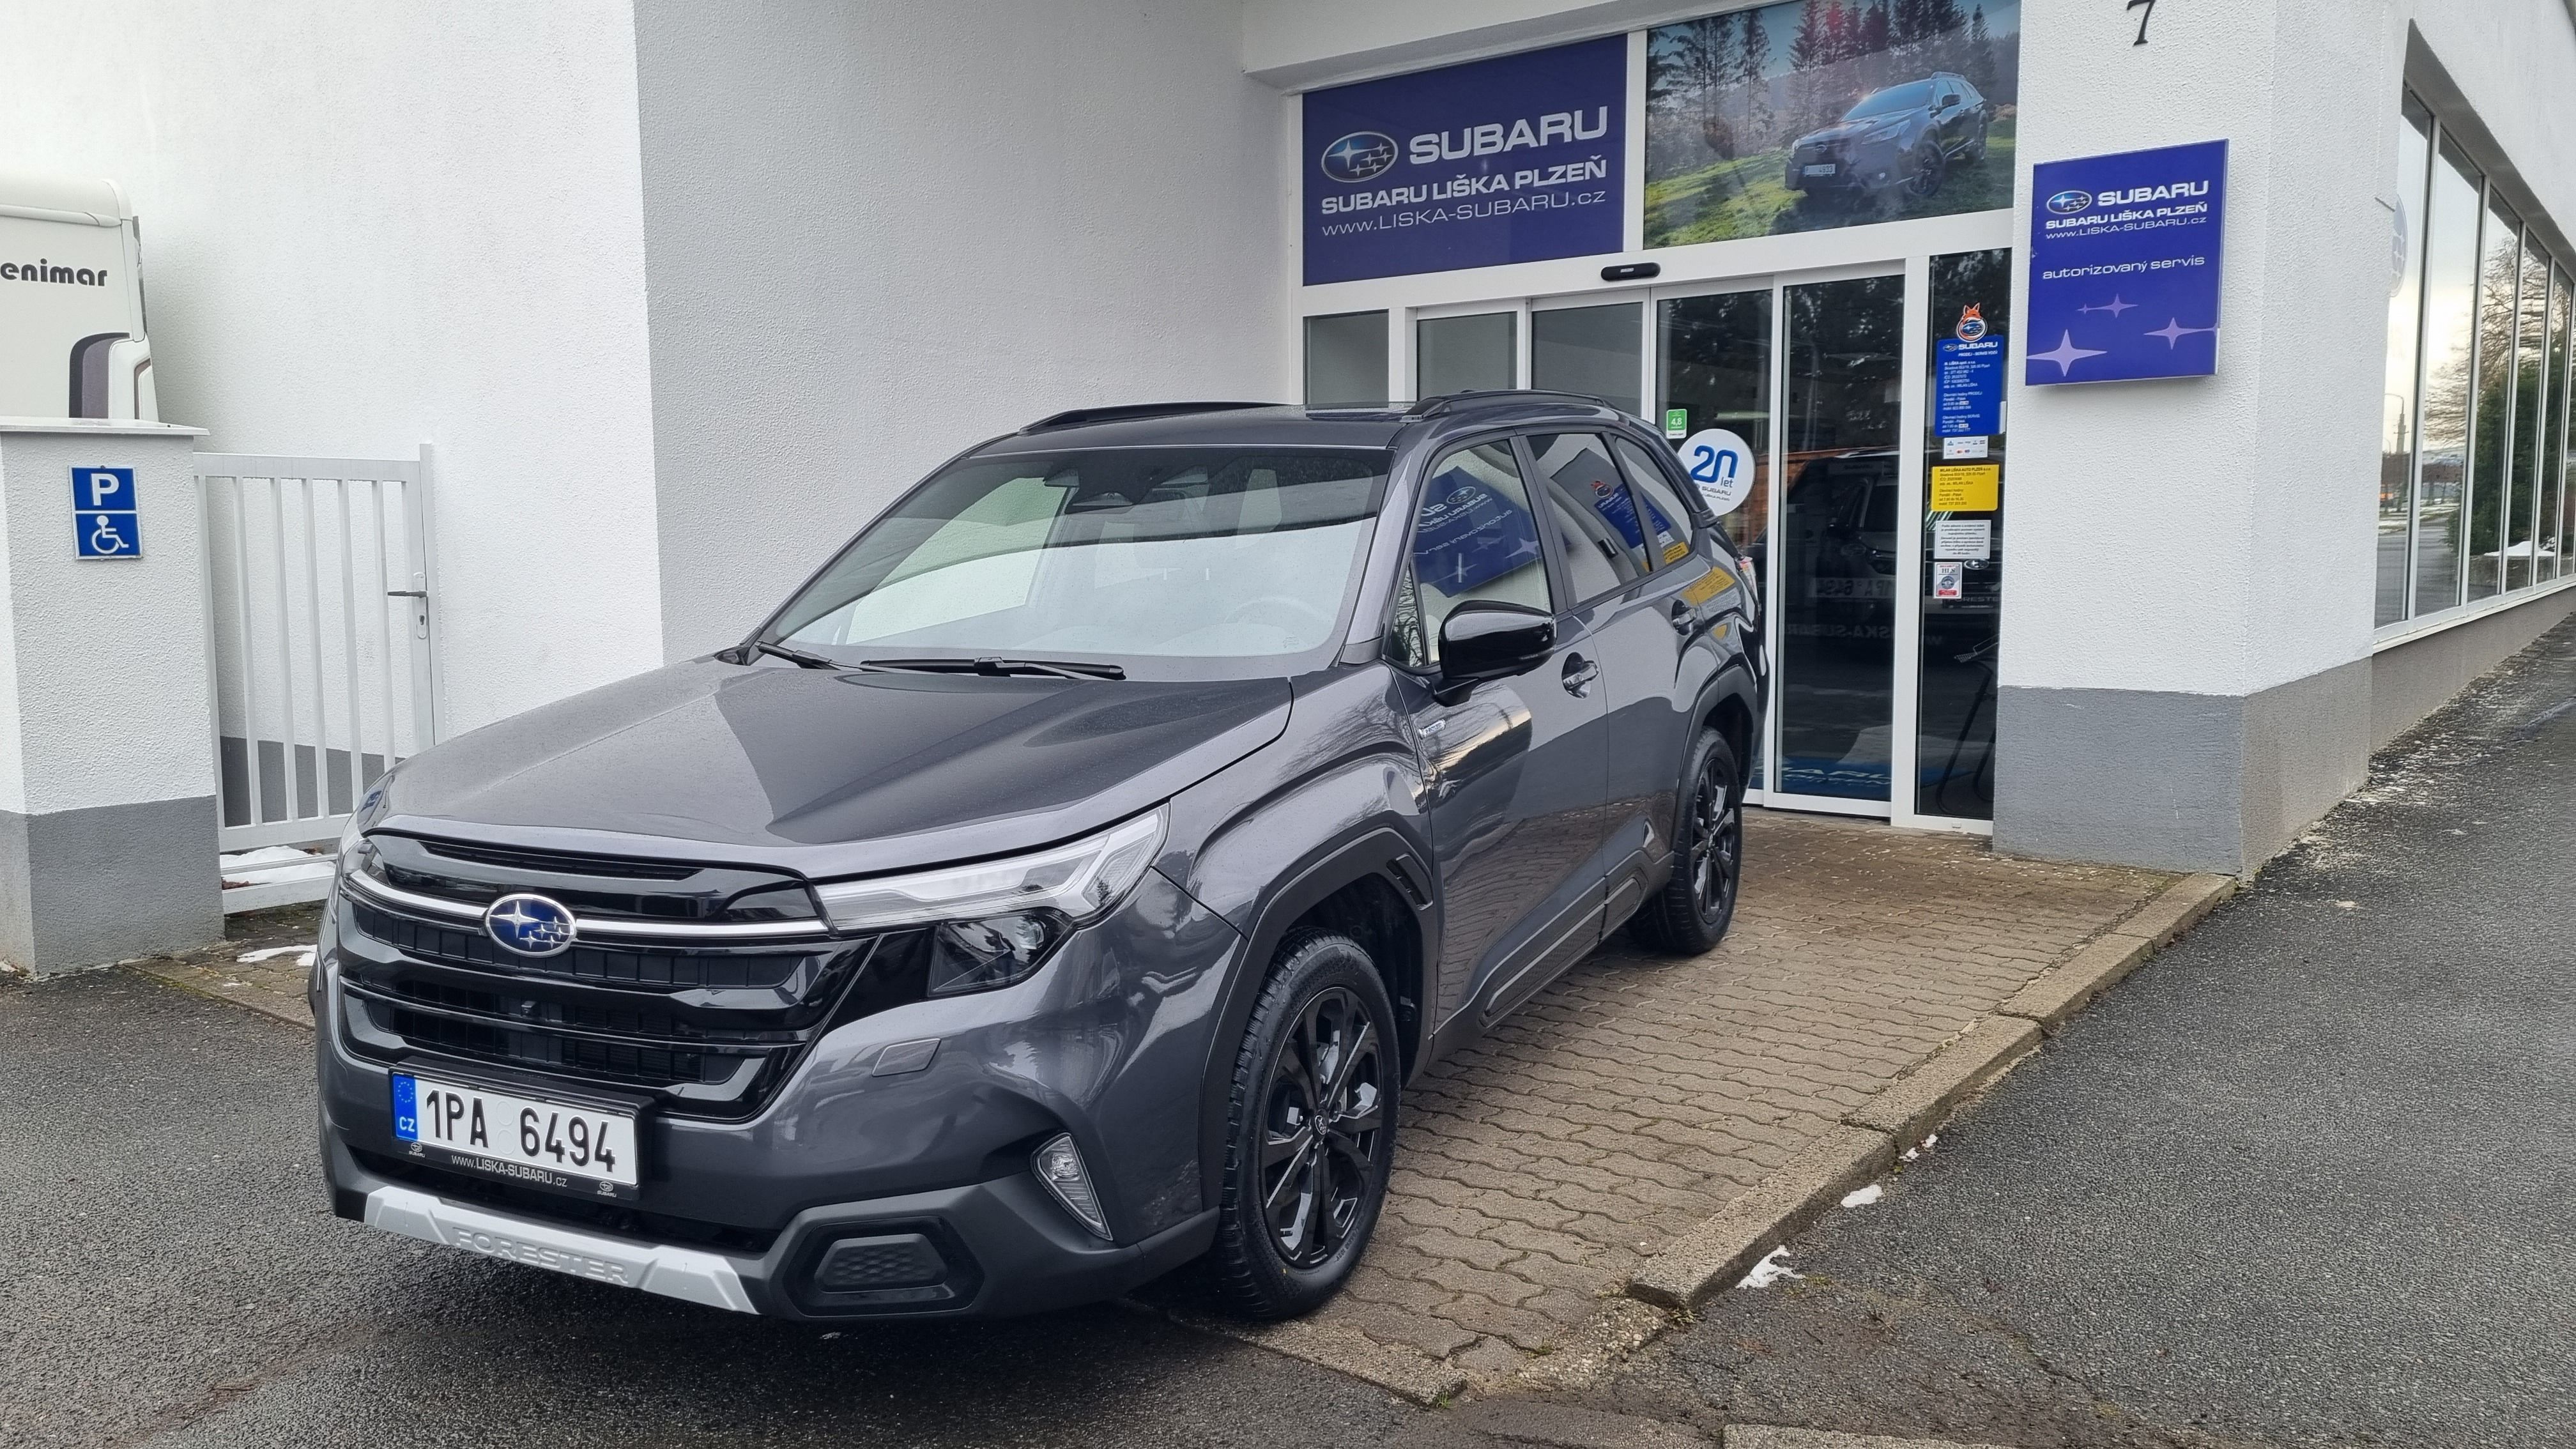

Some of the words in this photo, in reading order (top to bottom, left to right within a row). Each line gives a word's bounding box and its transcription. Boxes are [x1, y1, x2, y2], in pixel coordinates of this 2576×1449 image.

[2127, 0, 2155, 46] 7
[1409, 105, 1608, 164] SUBARU
[1321, 183, 1430, 215] SUBARU
[1433, 174, 1510, 201] LIŠKA
[1515, 155, 1607, 189] PLZEŇ
[2097, 180, 2209, 207] SUBARU
[1321, 190, 1607, 236] www.LISKA-SUBARU.cz
[2046, 214, 2108, 229] SUBARU
[2110, 210, 2154, 222] LIŠKA
[2156, 201, 2208, 217] PLZEŇ
[2046, 216, 2207, 240] www.LISKA-SUBARU.cz
[0, 258, 108, 287] enimar
[2043, 260, 2147, 280] autorizovaný
[2150, 255, 2205, 270] servis
[1958, 342, 1998, 350] SUBARU
[91, 473, 119, 506] P
[1701, 486, 1731, 496] SUBARU
[1721, 476, 1733, 488] let
[399, 1116, 415, 1133] CZ
[426, 1089, 489, 1149] 1PA
[519, 1107, 616, 1173] 6494
[452, 1226, 629, 1284] FORESTER
